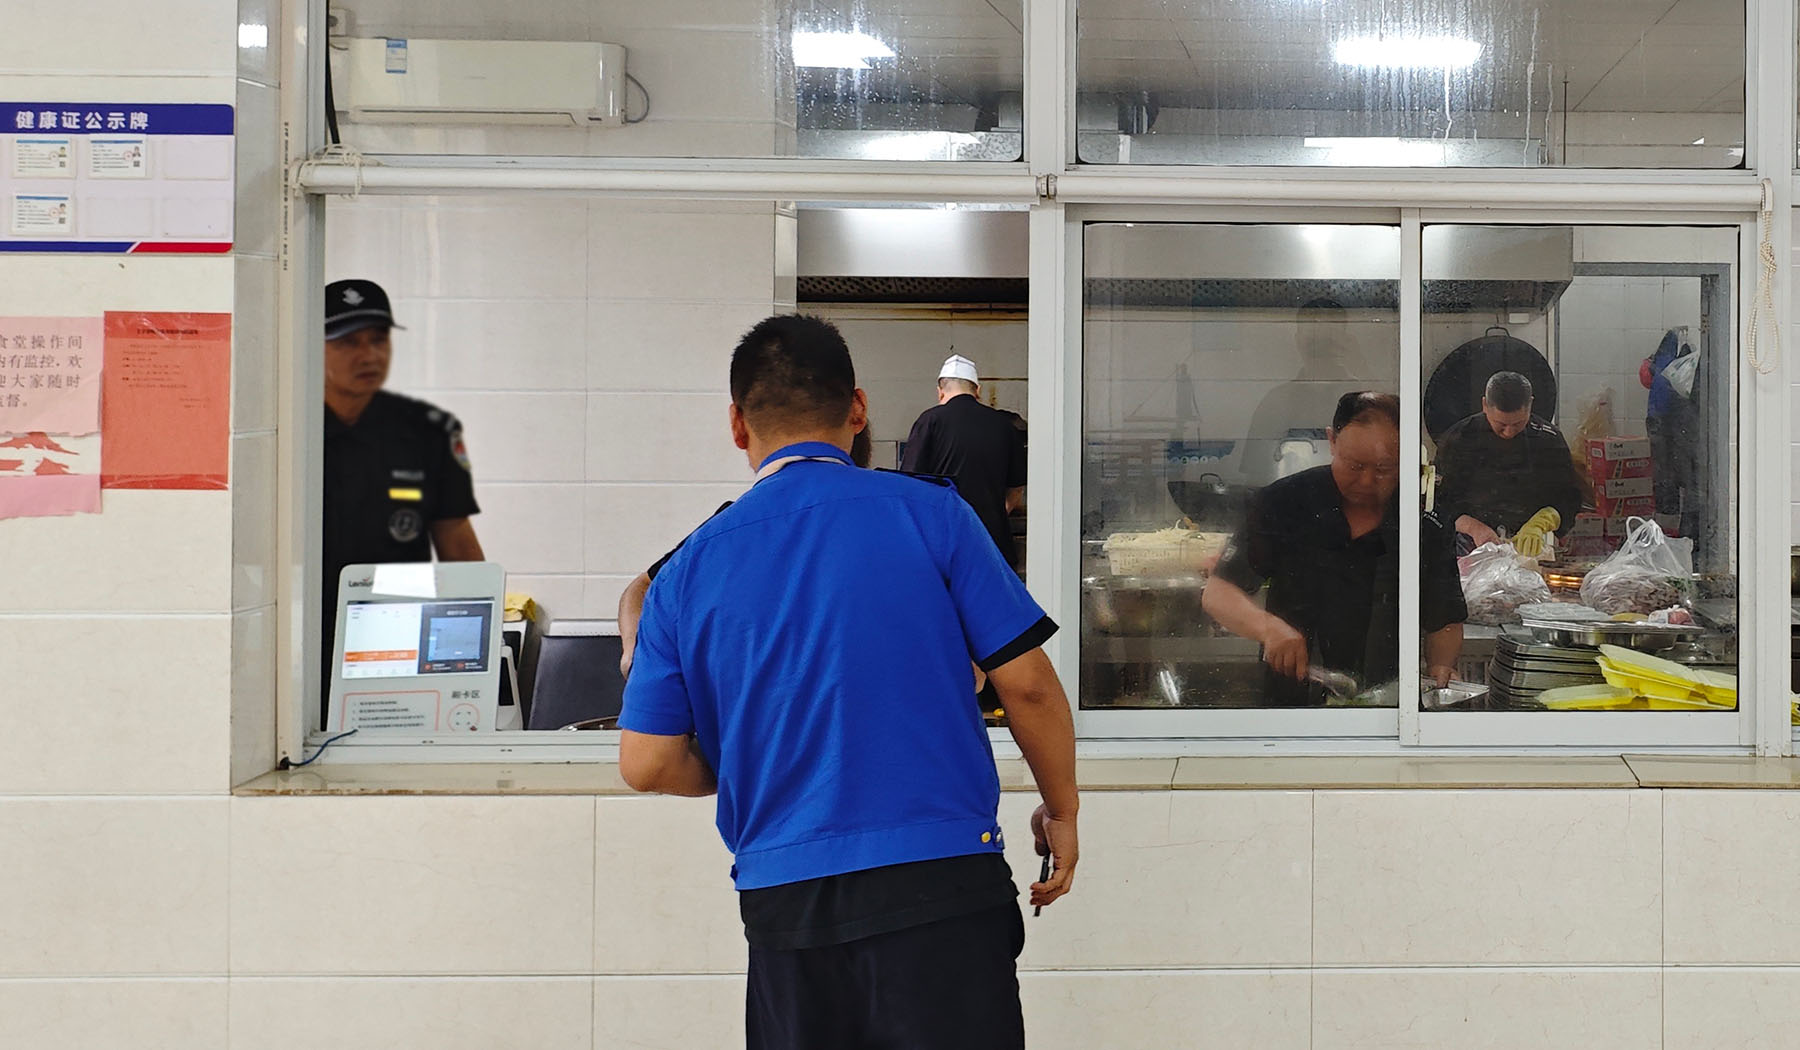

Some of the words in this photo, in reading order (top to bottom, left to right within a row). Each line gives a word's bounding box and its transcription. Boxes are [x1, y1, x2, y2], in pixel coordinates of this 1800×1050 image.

[15, 111, 149, 130] 健康证公示牌
